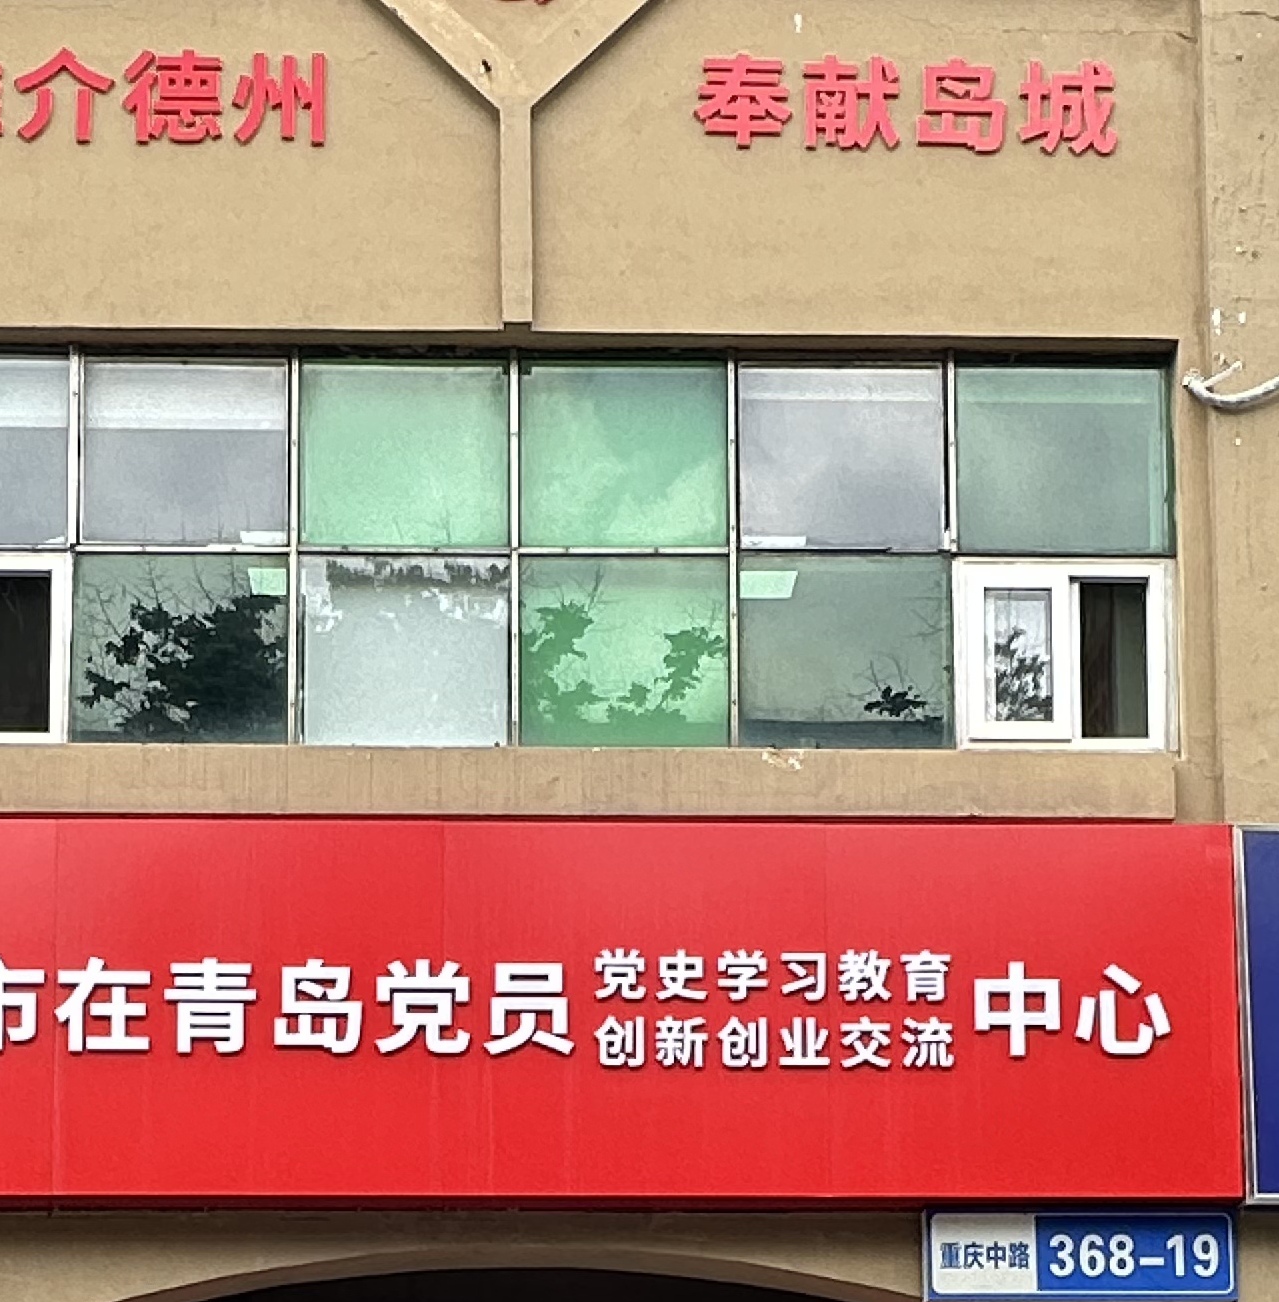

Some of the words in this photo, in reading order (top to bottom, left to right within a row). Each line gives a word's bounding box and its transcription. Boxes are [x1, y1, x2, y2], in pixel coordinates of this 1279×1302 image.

[695, 54, 1118, 157] 奉献岛城
[594, 949, 951, 1002] 党史学习教育
[973, 961, 1171, 1057] 中心
[594, 1016, 954, 1068] 创新创业交流
[940, 1241, 1030, 1269] 重庆中路
[1050, 1234, 1220, 1277] 368-19
